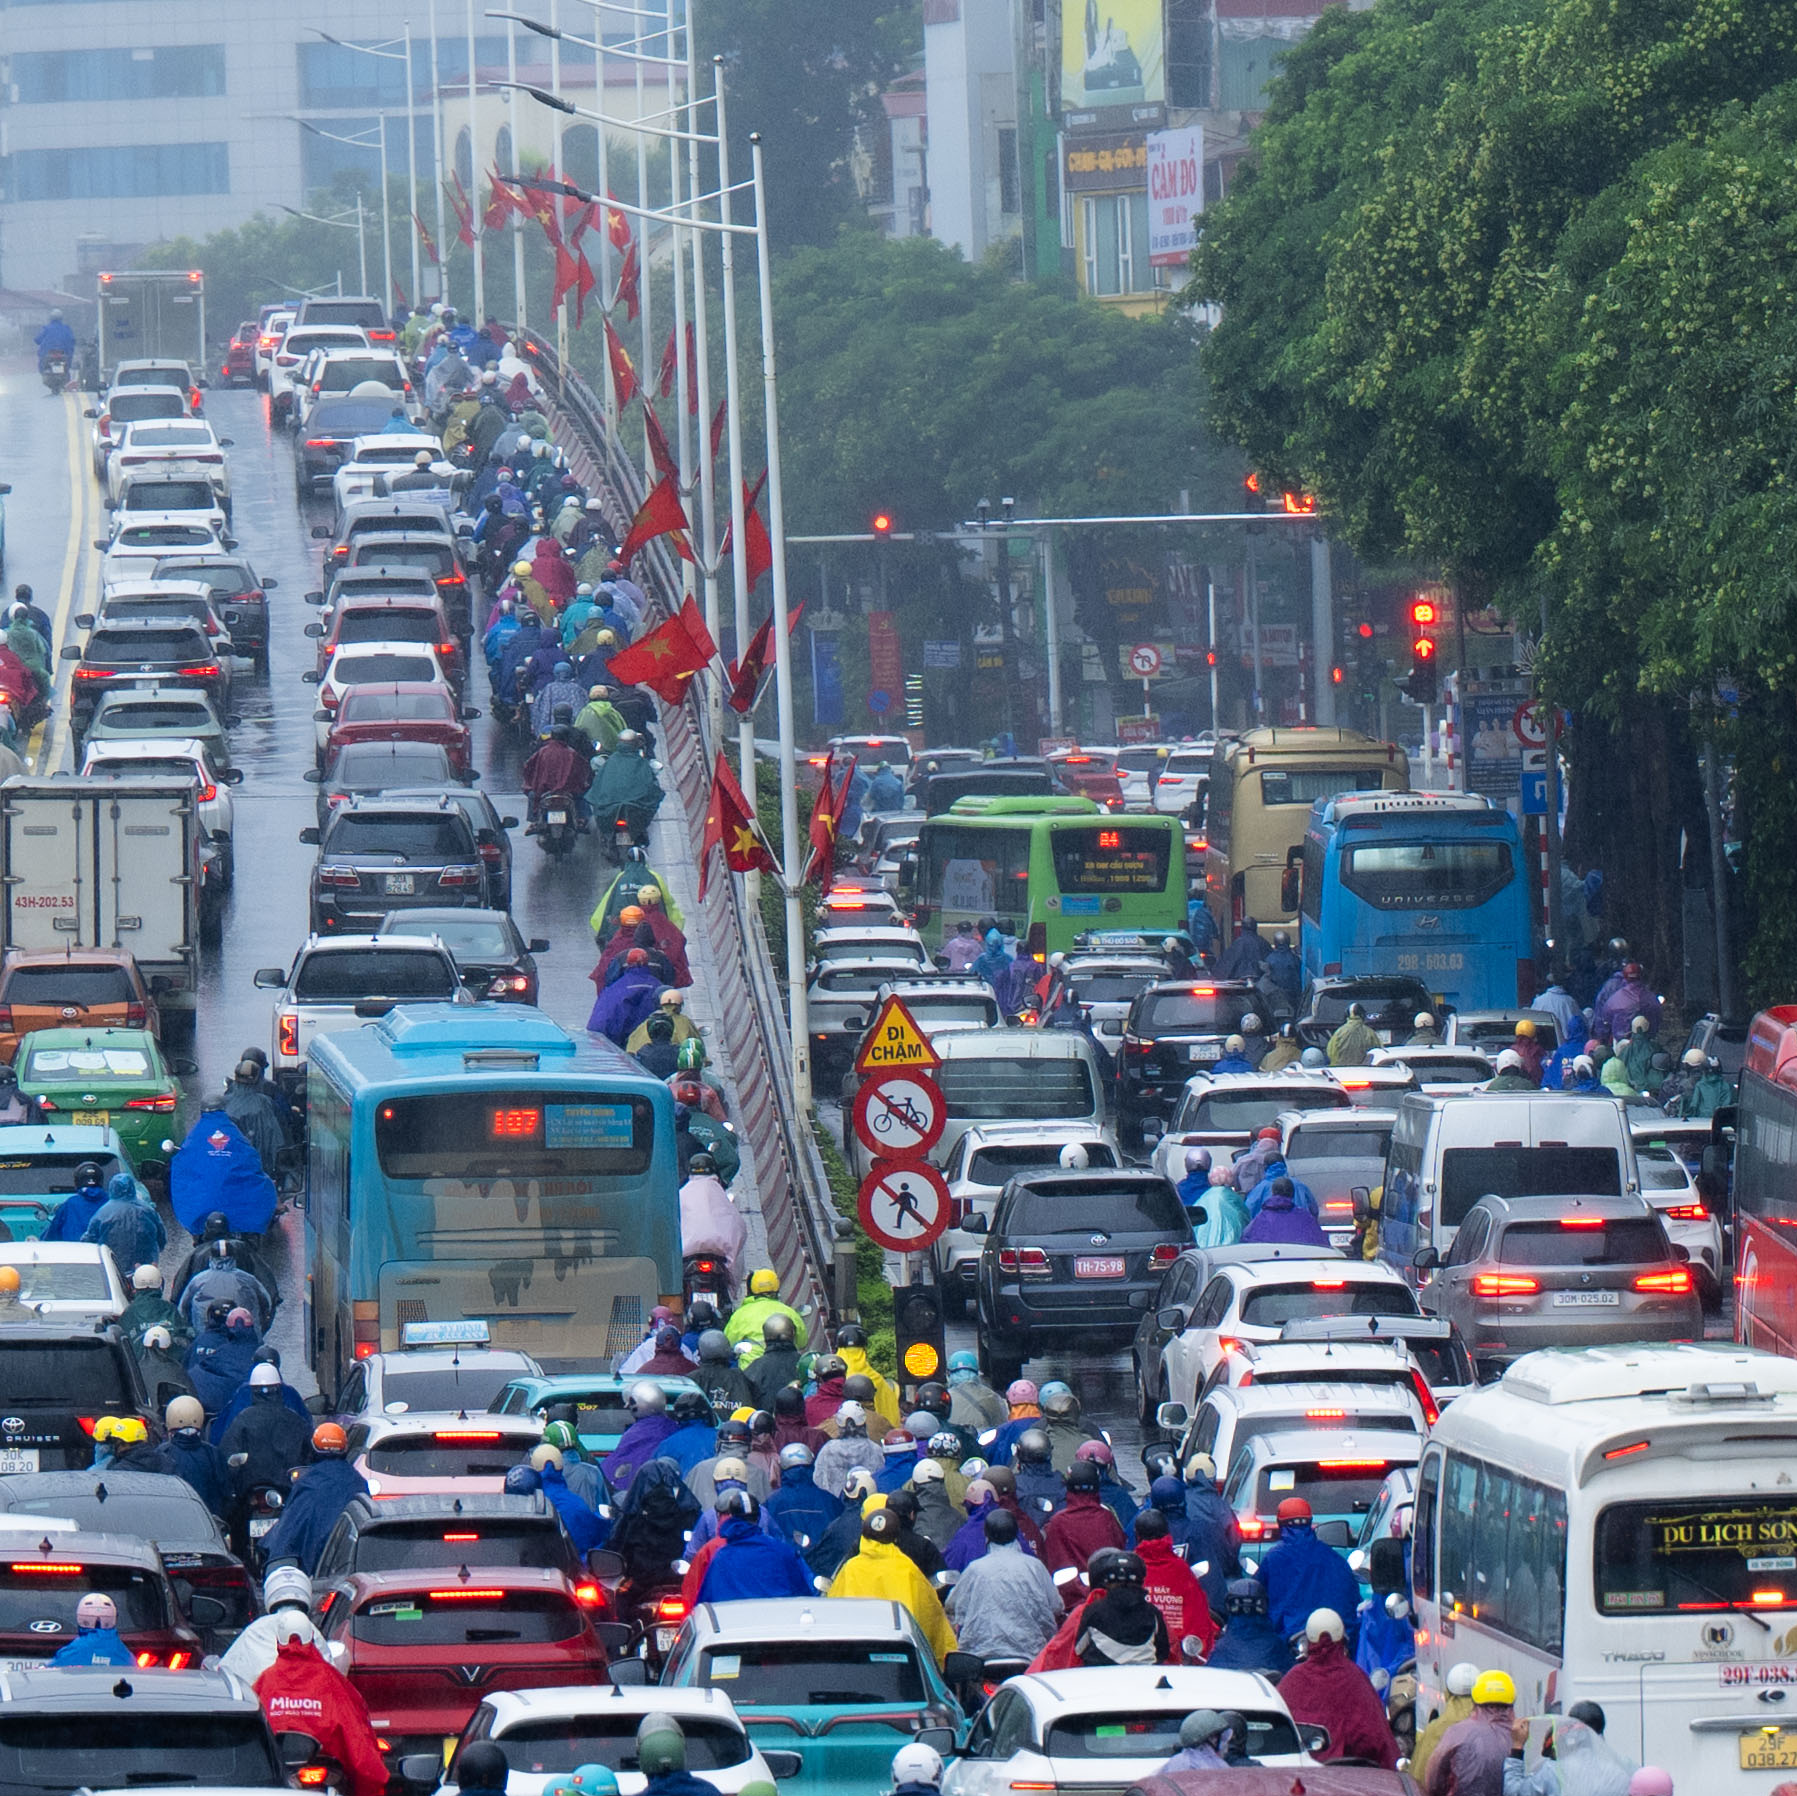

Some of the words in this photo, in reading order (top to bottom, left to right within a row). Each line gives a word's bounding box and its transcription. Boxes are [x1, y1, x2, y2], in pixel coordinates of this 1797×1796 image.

[15, 896, 74, 908] 43H-202.53
[1382, 894, 1474, 903] UNIVERSE
[887, 1026, 904, 1041] ĐI
[871, 1042, 922, 1063] CHẬM
[495, 1110, 538, 1135] 107
[1076, 1260, 1124, 1273] TH-75-98
[6, 1435, 61, 1443] CRUISER
[2, 1449, 25, 1461] 30K
[1664, 1526, 1692, 1543] DU
[1700, 1522, 1753, 1548] LỊCH
[1601, 1650, 1665, 1662] THACO
[270, 1696, 323, 1710] Miwon
[1758, 1737, 1786, 1751] 29F
[1746, 1752, 1797, 1766] 038.27
